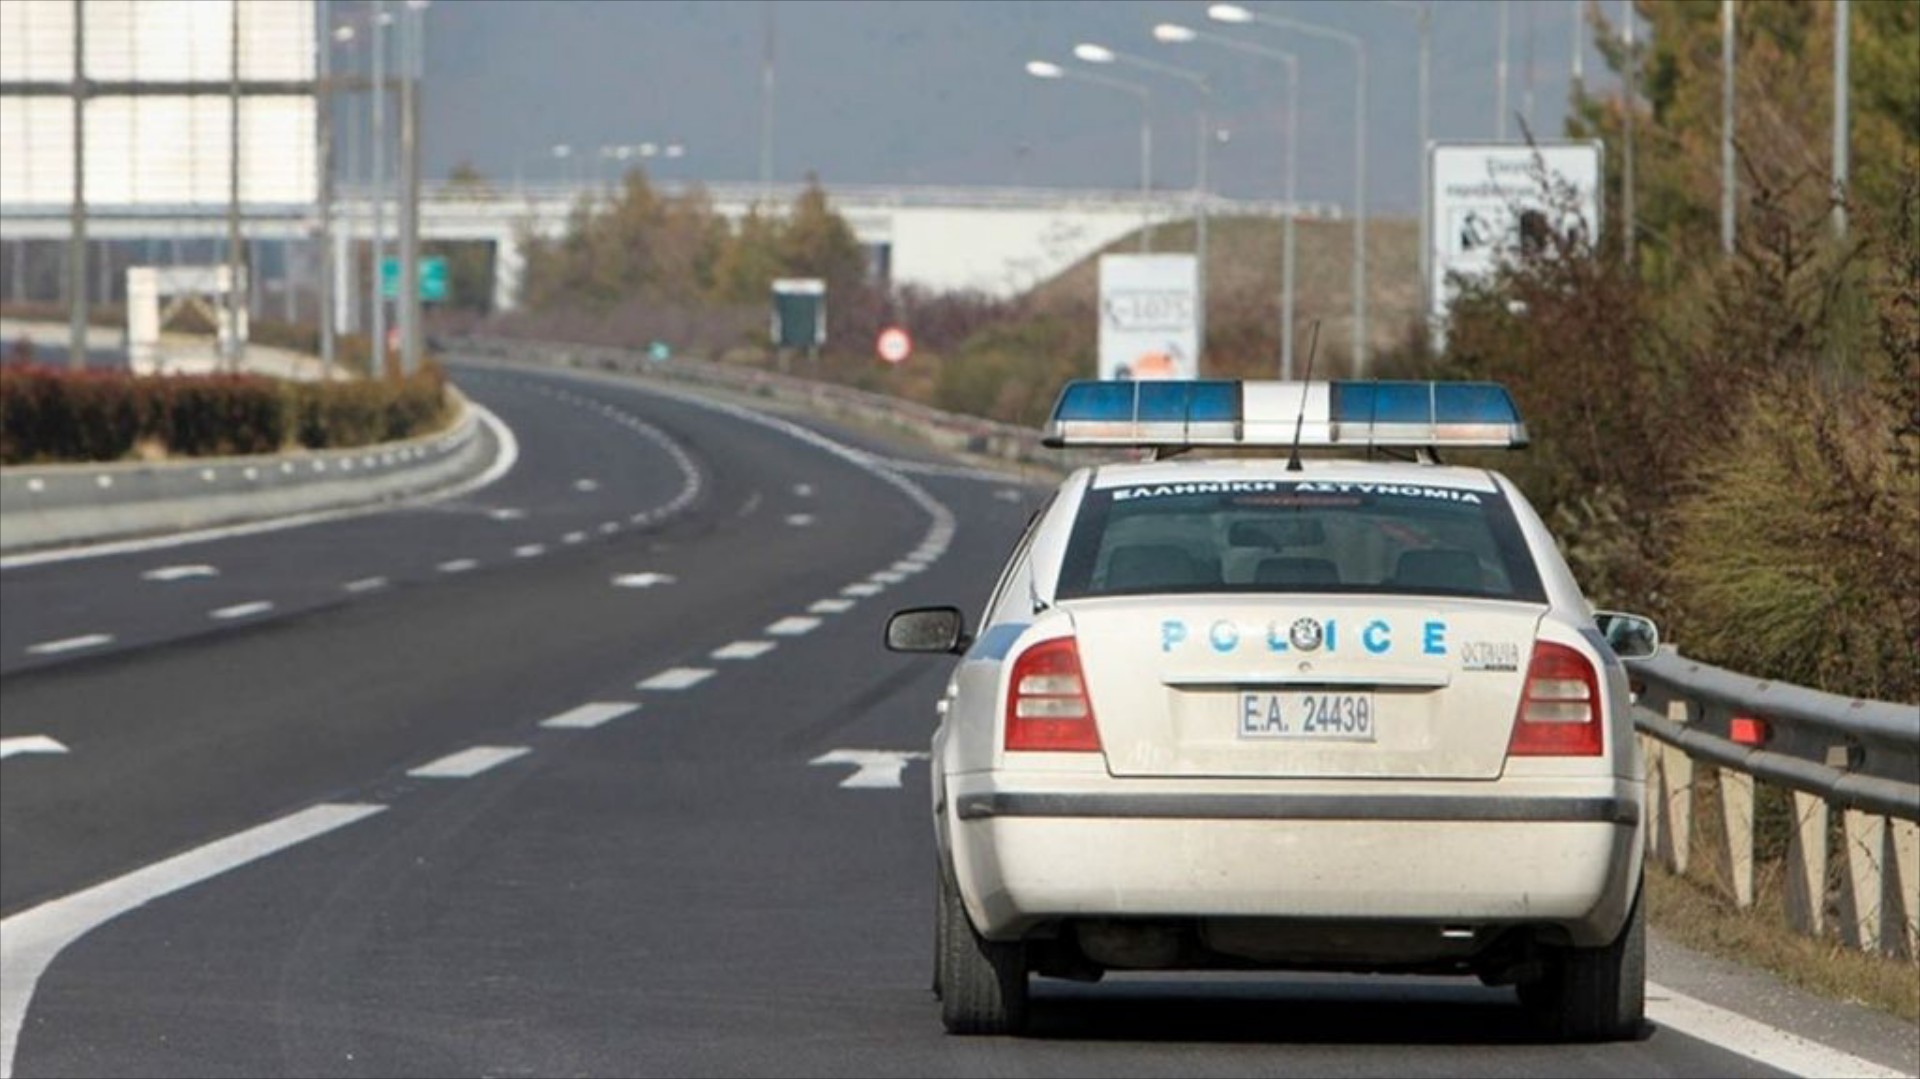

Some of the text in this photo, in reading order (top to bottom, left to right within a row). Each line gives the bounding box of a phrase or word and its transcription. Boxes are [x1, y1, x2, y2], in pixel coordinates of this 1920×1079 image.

[1112, 482, 1483, 505] ΕΛΛΗΝΙΚΗ ΑΣΤΥΝΟΜΙΑ
[1161, 619, 1447, 654] POLICE
